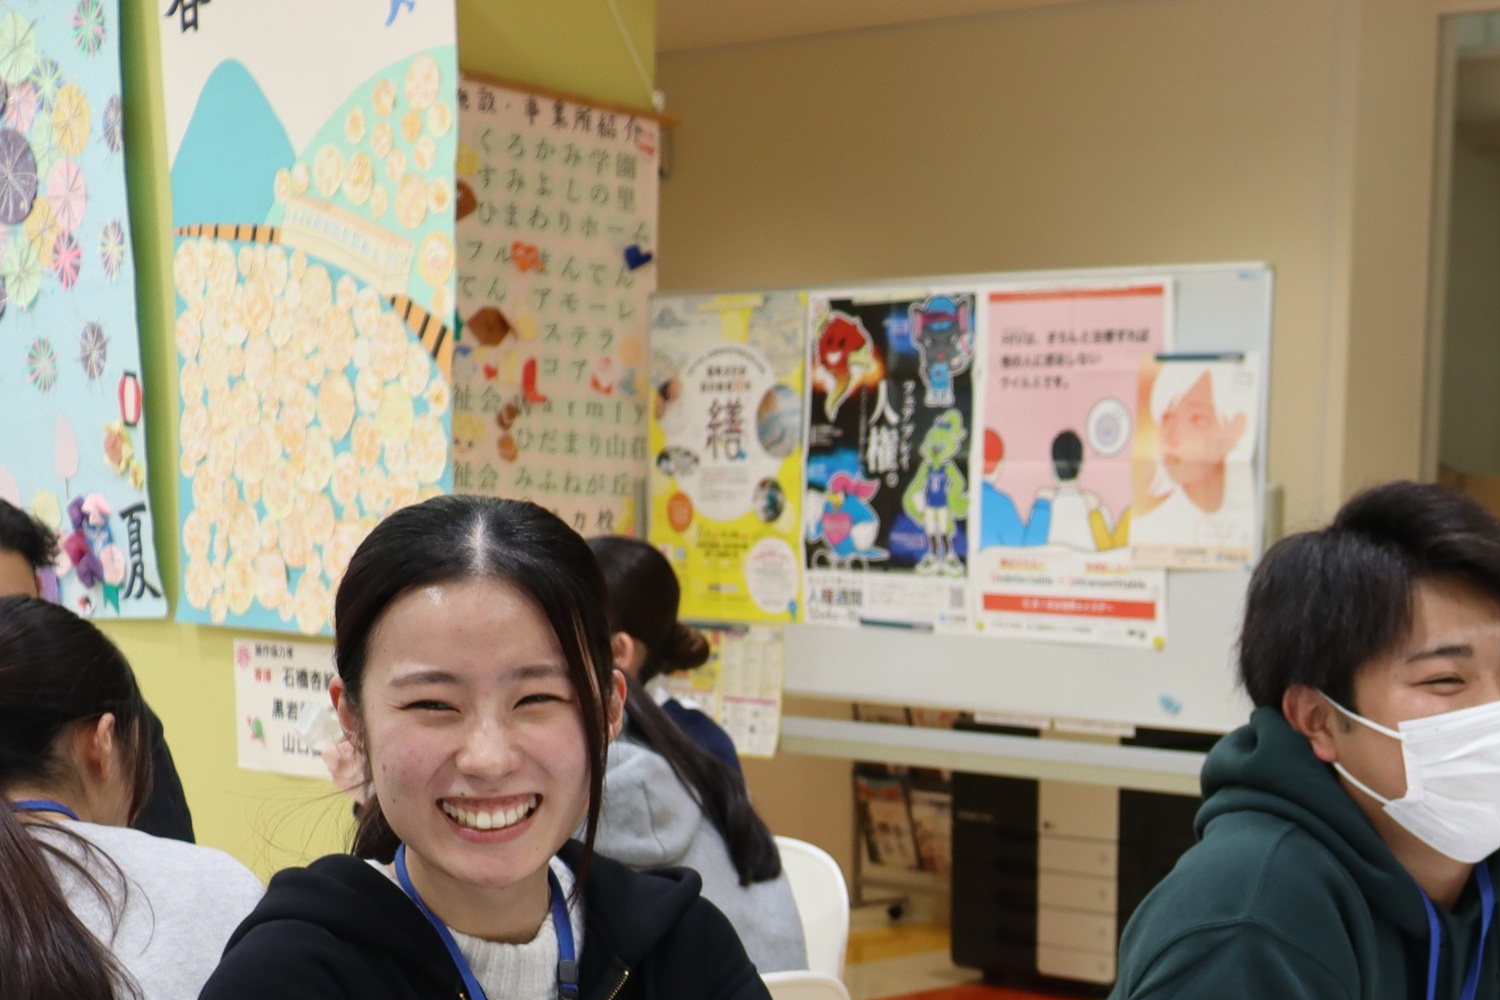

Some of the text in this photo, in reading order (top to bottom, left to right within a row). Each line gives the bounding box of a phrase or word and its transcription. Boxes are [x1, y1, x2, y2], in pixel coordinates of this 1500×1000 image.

[479, 127, 637, 180] くろかみ学園
[477, 163, 637, 212] すみよしの里
[478, 198, 649, 242] ひまわりホーム
[542, 322, 615, 350] ステラ
[541, 358, 588, 383] コア
[119, 503, 162, 600] 夏
